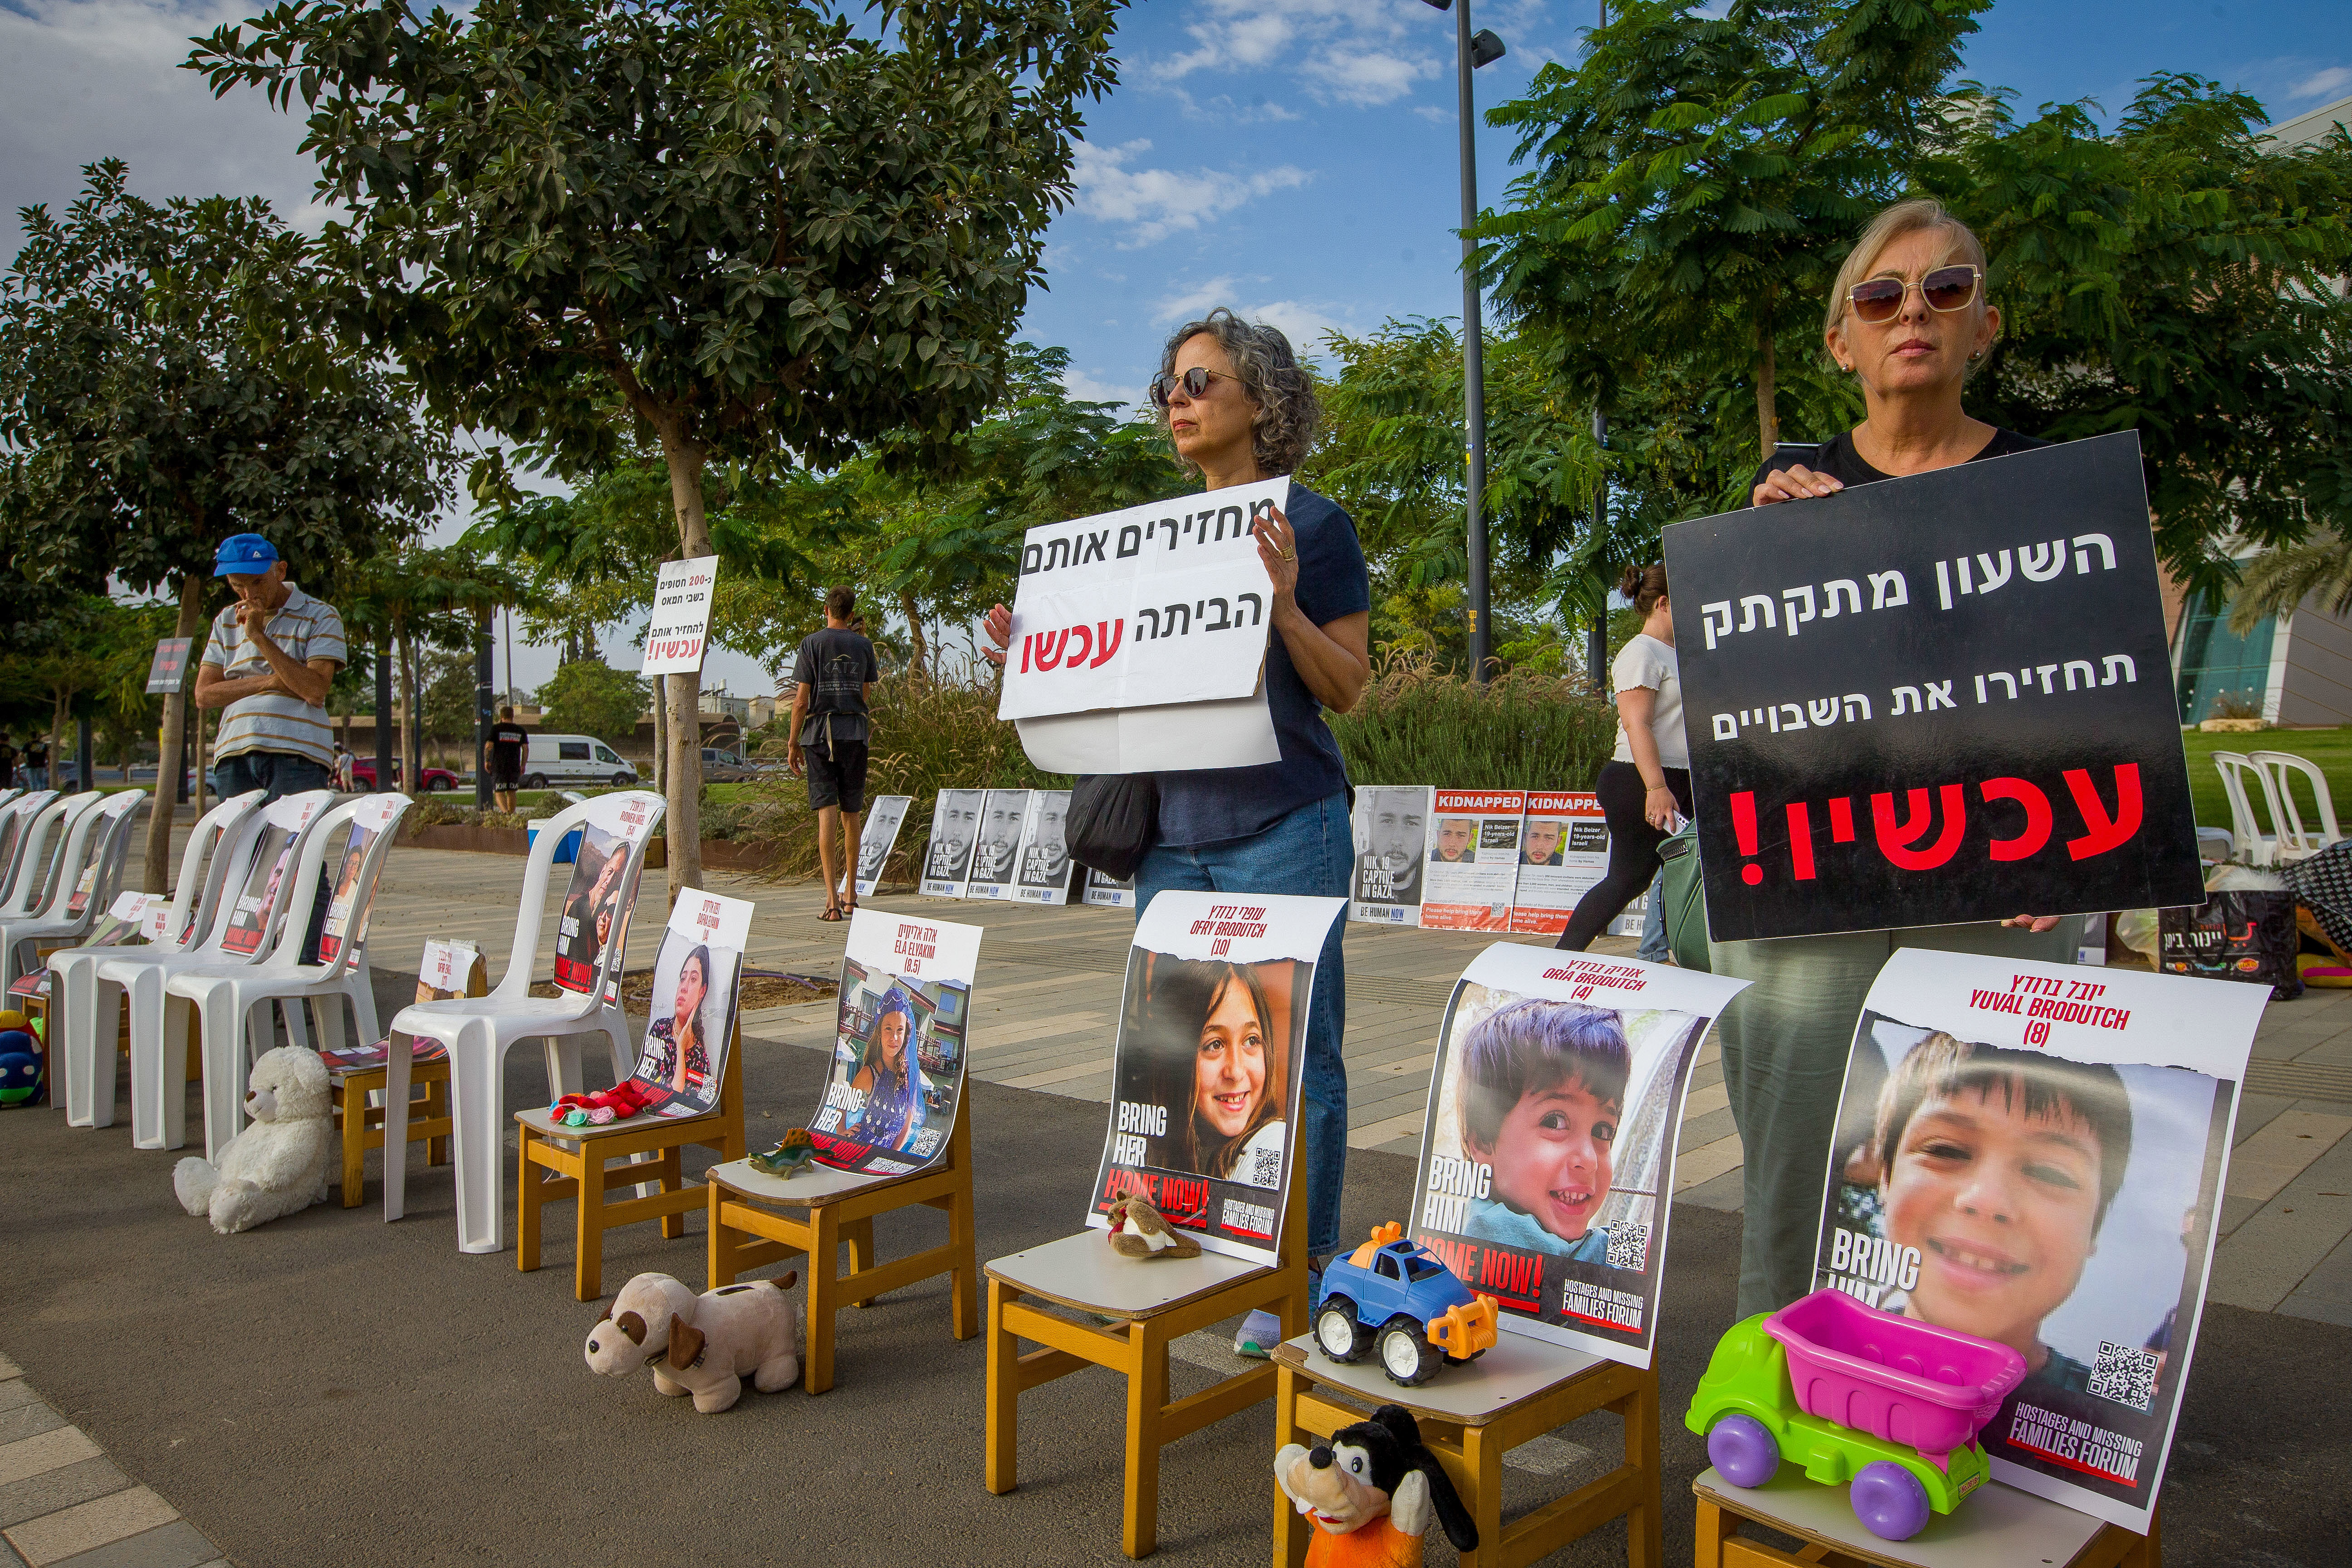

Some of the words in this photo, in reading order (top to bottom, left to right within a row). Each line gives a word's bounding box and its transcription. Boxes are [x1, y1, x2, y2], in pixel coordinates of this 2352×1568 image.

[1117, 498, 1275, 559] מחזירים
[1021, 529, 1109, 576] אותם
[1936, 533, 2117, 611] השעון
[660, 578, 686, 590] חטופים
[662, 595, 683, 606] חמאס
[686, 593, 704, 603] בשבי
[1135, 593, 1262, 642] הביתה
[1701, 569, 1909, 650] מתקתק
[652, 627, 672, 637] אותם
[675, 621, 704, 635] להחזיר
[648, 638, 701, 661] עכשיו!
[1020, 618, 1124, 674] עכשו
[822, 662, 859, 674] KATZ
[1975, 654, 2137, 704] תחזירו
[1891, 680, 1956, 716] את
[1712, 693, 1872, 741] השבויים
[1438, 796, 1522, 808] KIDNAPPED
[1527, 798, 1602, 810] KIDNAPPE
[1730, 763, 2144, 886] עכשיו!
[934, 843, 944, 855] NIK,
[945, 843, 952, 854] 19
[989, 845, 996, 857] 19
[1029, 847, 1040, 859] NIK,
[1041, 848, 1049, 859] 19
[932, 853, 953, 866] CAPTIVE
[1026, 858, 1051, 871] CAPTIVE
[1363, 856, 1379, 871] NIK,
[1382, 856, 1391, 870] 19
[930, 865, 936, 877] IN
[936, 866, 950, 877] GAZA.
[972, 867, 980, 879] IN
[979, 867, 994, 879] GAZA.
[1023, 870, 1030, 882] IN
[1030, 871, 1047, 883] GAZA.
[1094, 871, 1101, 883] IN
[1362, 869, 1395, 885] CAPTIVE
[927, 882, 932, 891] BE
[932, 883, 945, 892] HUMAN
[945, 884, 955, 893] NOW
[975, 886, 989, 894] HUMAN
[989, 887, 1000, 895] NOW
[1020, 889, 1026, 898] BE
[1026, 889, 1041, 899] HUMAN
[1041, 891, 1053, 900] NOW
[1091, 891, 1097, 900] BE
[1097, 891, 1112, 901] HUMAN
[1112, 892, 1122, 902] NOW
[1362, 883, 1371, 898] IN
[1372, 884, 1394, 899] GAZA.
[237, 896, 261, 913] BRING
[328, 902, 349, 920] BRING
[1208, 905, 1238, 920] ברודץ
[1239, 906, 1267, 921] עופרי
[1361, 906, 1368, 916] BE
[1369, 907, 1390, 918] HUMAN
[1391, 908, 1405, 920] NOW
[230, 911, 248, 927] HIM
[324, 918, 338, 935] HER
[560, 915, 580, 938] BRING
[1625, 919, 1635, 930] BE
[897, 924, 923, 941] אליקים
[923, 927, 938, 943] אלה
[1190, 920, 1217, 935] OFRY
[1214, 921, 1268, 938] BRODUTCH
[557, 935, 571, 956] HIM
[894, 940, 907, 955] ELA
[908, 942, 936, 960] ELYAKIM
[1210, 938, 1231, 957] (10)
[555, 956, 572, 979] HOME
[570, 961, 593, 985] NOW!
[904, 957, 921, 975] (8.5)
[1566, 960, 1607, 973] ברודץ
[1603, 965, 1646, 978] אוריה
[1542, 968, 1576, 981] ORIA
[1573, 972, 1648, 991] BRODUTCH
[2010, 974, 2064, 996] ברודץ
[1570, 985, 1595, 1001] (4)
[2066, 980, 2107, 1001] יובל
[1969, 989, 2024, 1015] YUVAL
[2026, 997, 2131, 1031] BRODUTCH
[2023, 1019, 2051, 1048] (8)
[644, 1034, 665, 1061] BRING
[636, 1056, 656, 1080] HER
[826, 1082, 863, 1113] BRING
[813, 1107, 843, 1133] HER
[1118, 1101, 1167, 1137] BRING
[1112, 1133, 1147, 1167] HER
[1429, 1154, 1493, 1200] BRING
[1161, 1177, 1209, 1215] NOW!
[1223, 1198, 1246, 1214] HOSTAGES
[1245, 1203, 1255, 1216] AND
[1254, 1205, 1275, 1220] MISSING
[1421, 1193, 1465, 1235] HIM
[1221, 1209, 1250, 1230] FAMILIES
[1249, 1215, 1274, 1236] FORUM
[1830, 1227, 1921, 1290] BRING
[1480, 1248, 1545, 1298] NOW!
[1564, 1278, 1598, 1298] HOSTAGES
[1597, 1287, 1613, 1302] AND
[1612, 1290, 1644, 1310] MISSING
[1562, 1291, 1606, 1320] FAMILIES
[1606, 1302, 1642, 1329] FORUM
[2015, 1401, 2069, 1432] HOSTAGES
[2068, 1419, 2092, 1440] AND
[2091, 1426, 2144, 1457] MISSING
[2009, 1417, 2079, 1460] FAMILIES
[2078, 1440, 2140, 1481] FORUM
